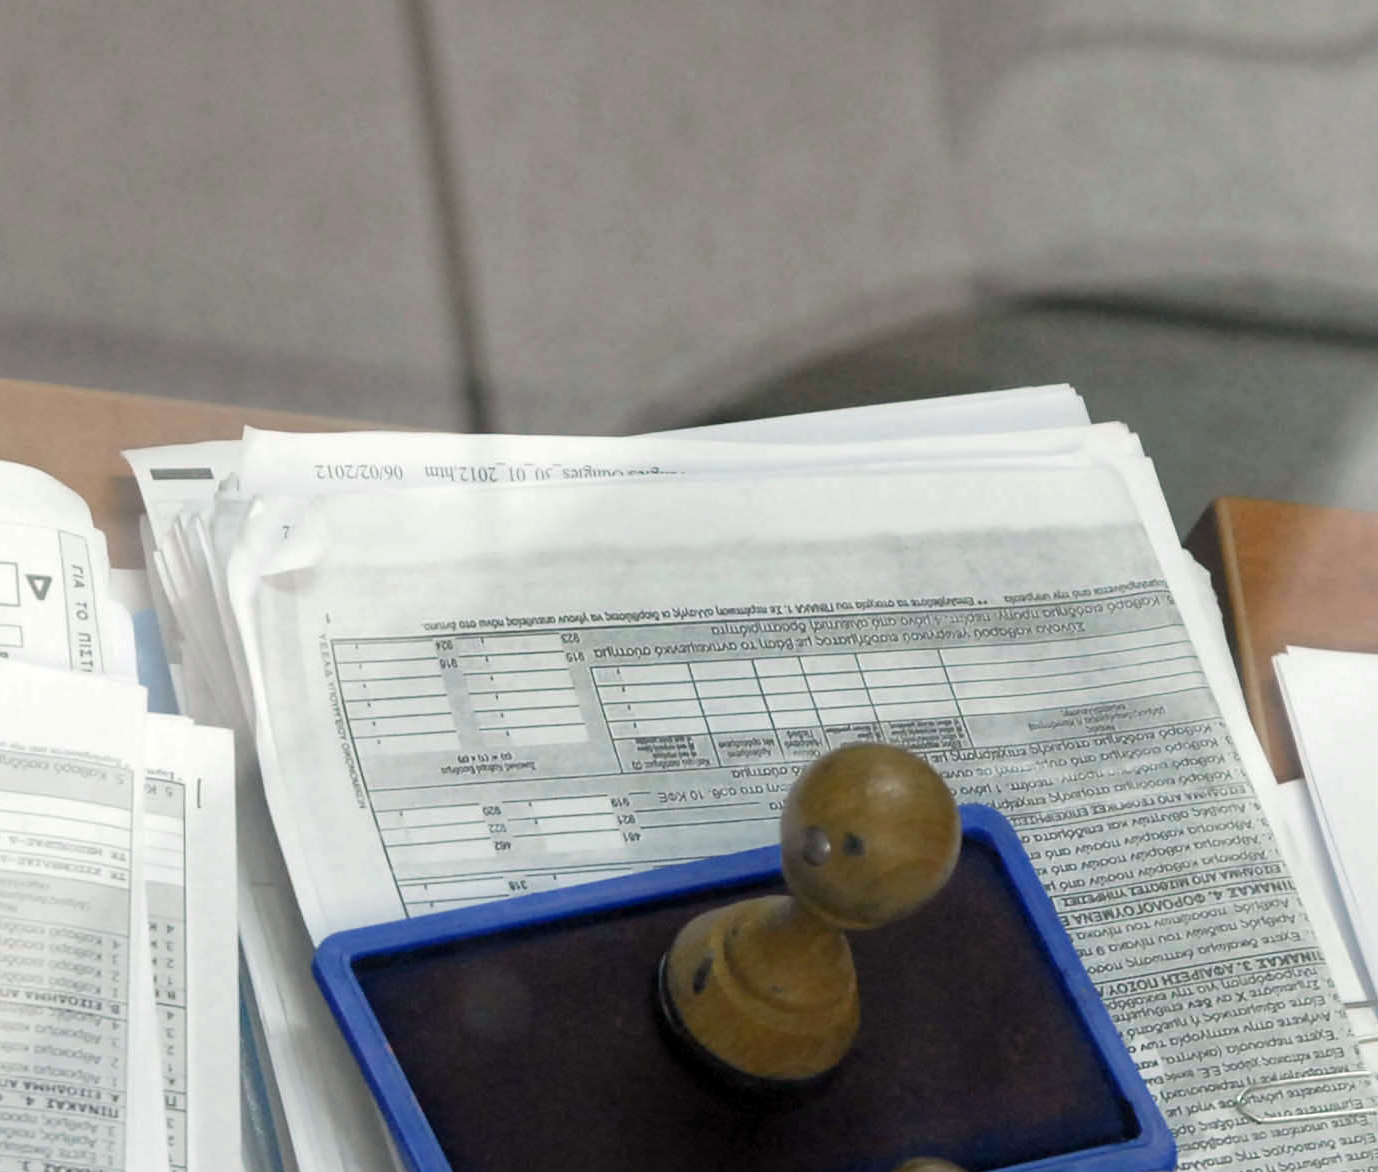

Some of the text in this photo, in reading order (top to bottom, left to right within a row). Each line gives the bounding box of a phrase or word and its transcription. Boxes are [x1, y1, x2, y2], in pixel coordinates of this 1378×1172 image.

[315, 464, 403, 480] 06/02/2012
[1161, 963, 1234, 986] ΑΦΑΙΡΕΣΗ
[1107, 976, 1157, 995] ΠΟΣΟΥ
